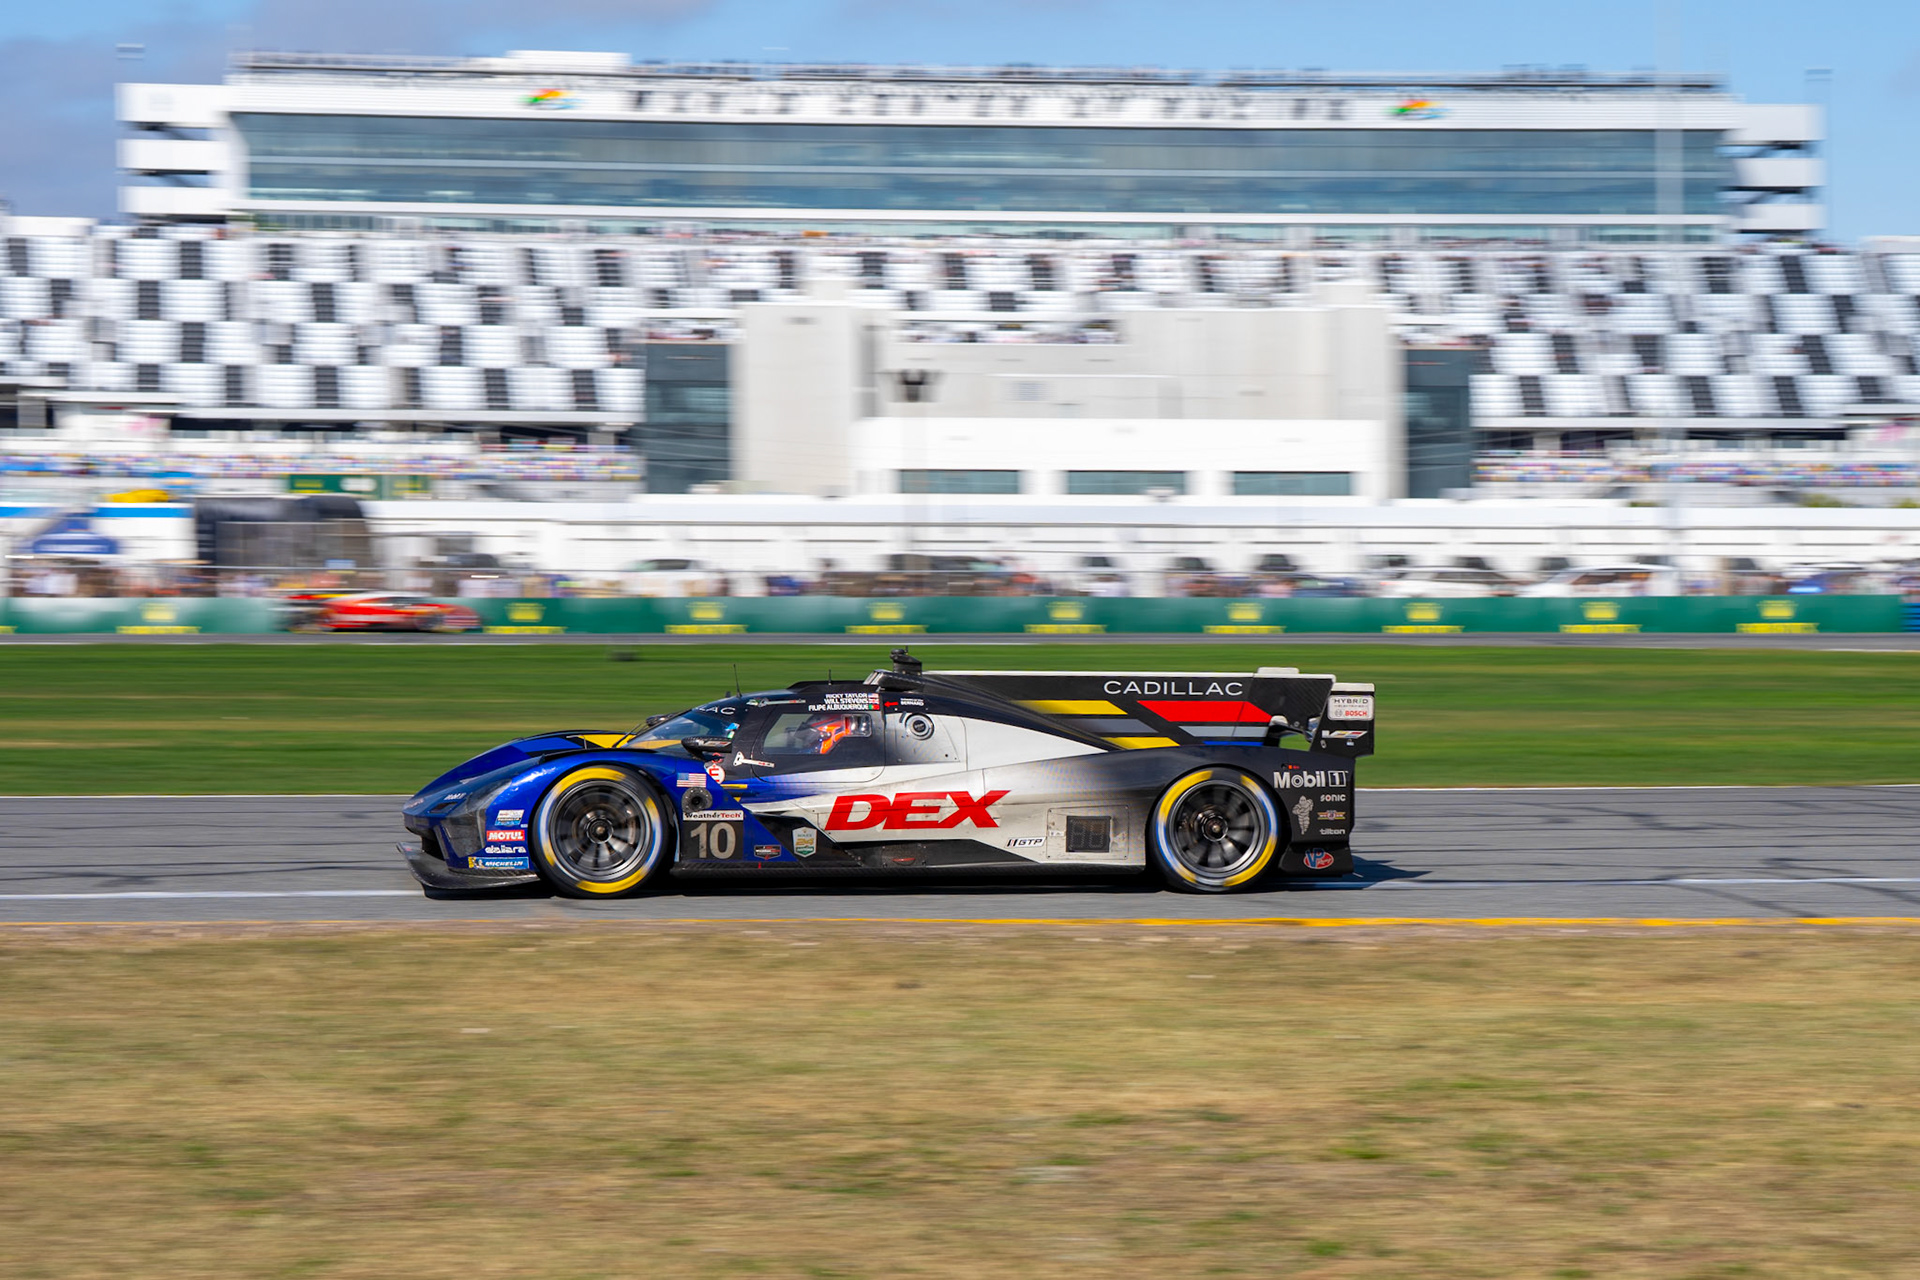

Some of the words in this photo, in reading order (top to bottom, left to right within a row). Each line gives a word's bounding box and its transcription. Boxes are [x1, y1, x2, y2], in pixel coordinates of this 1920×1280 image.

[1103, 680, 1244, 696] CADILLAC
[1273, 770, 1326, 789] Mobil
[824, 790, 1010, 831] DEX
[488, 832, 524, 841] MOTUL
[690, 822, 737, 860] 10
[1305, 848, 1325, 868] VP
